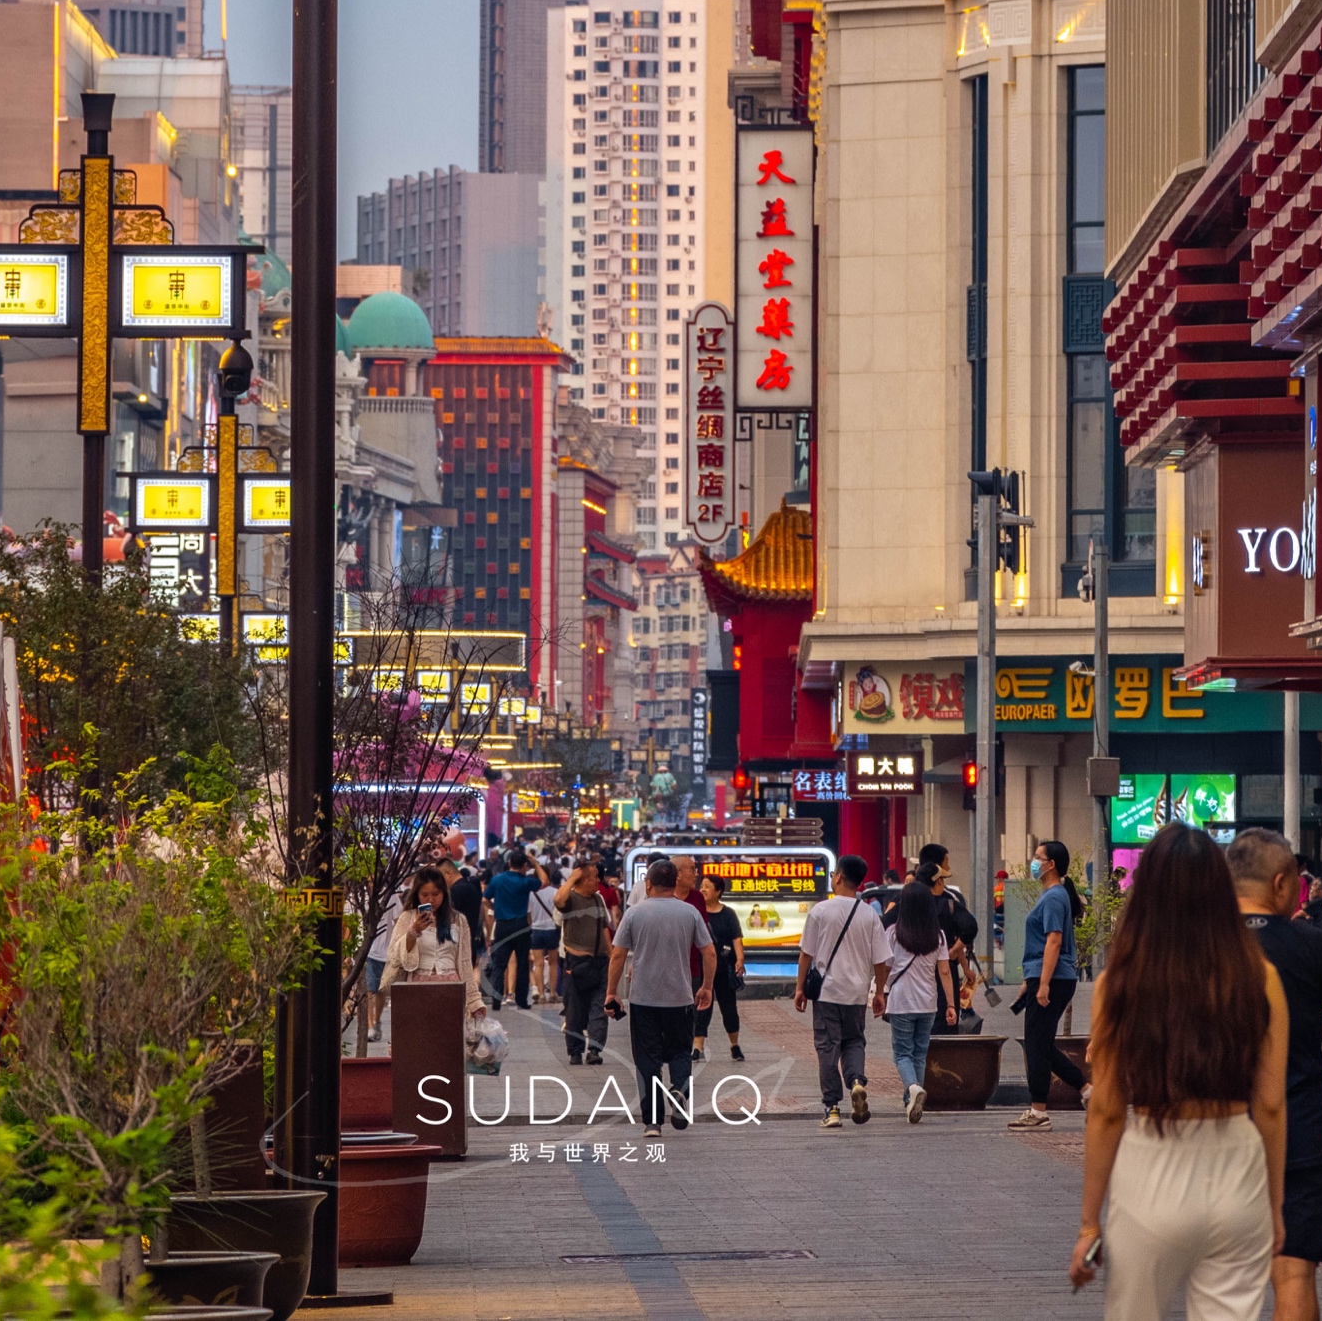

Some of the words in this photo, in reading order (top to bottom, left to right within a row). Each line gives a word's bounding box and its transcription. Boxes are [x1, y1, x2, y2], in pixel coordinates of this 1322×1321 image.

[857, 757, 915, 775] 周大福
[1194, 787, 1219, 812] 鲜奶
[702, 862, 814, 877] 中街地下商业街
[730, 879, 816, 892] 直通地铁一号线
